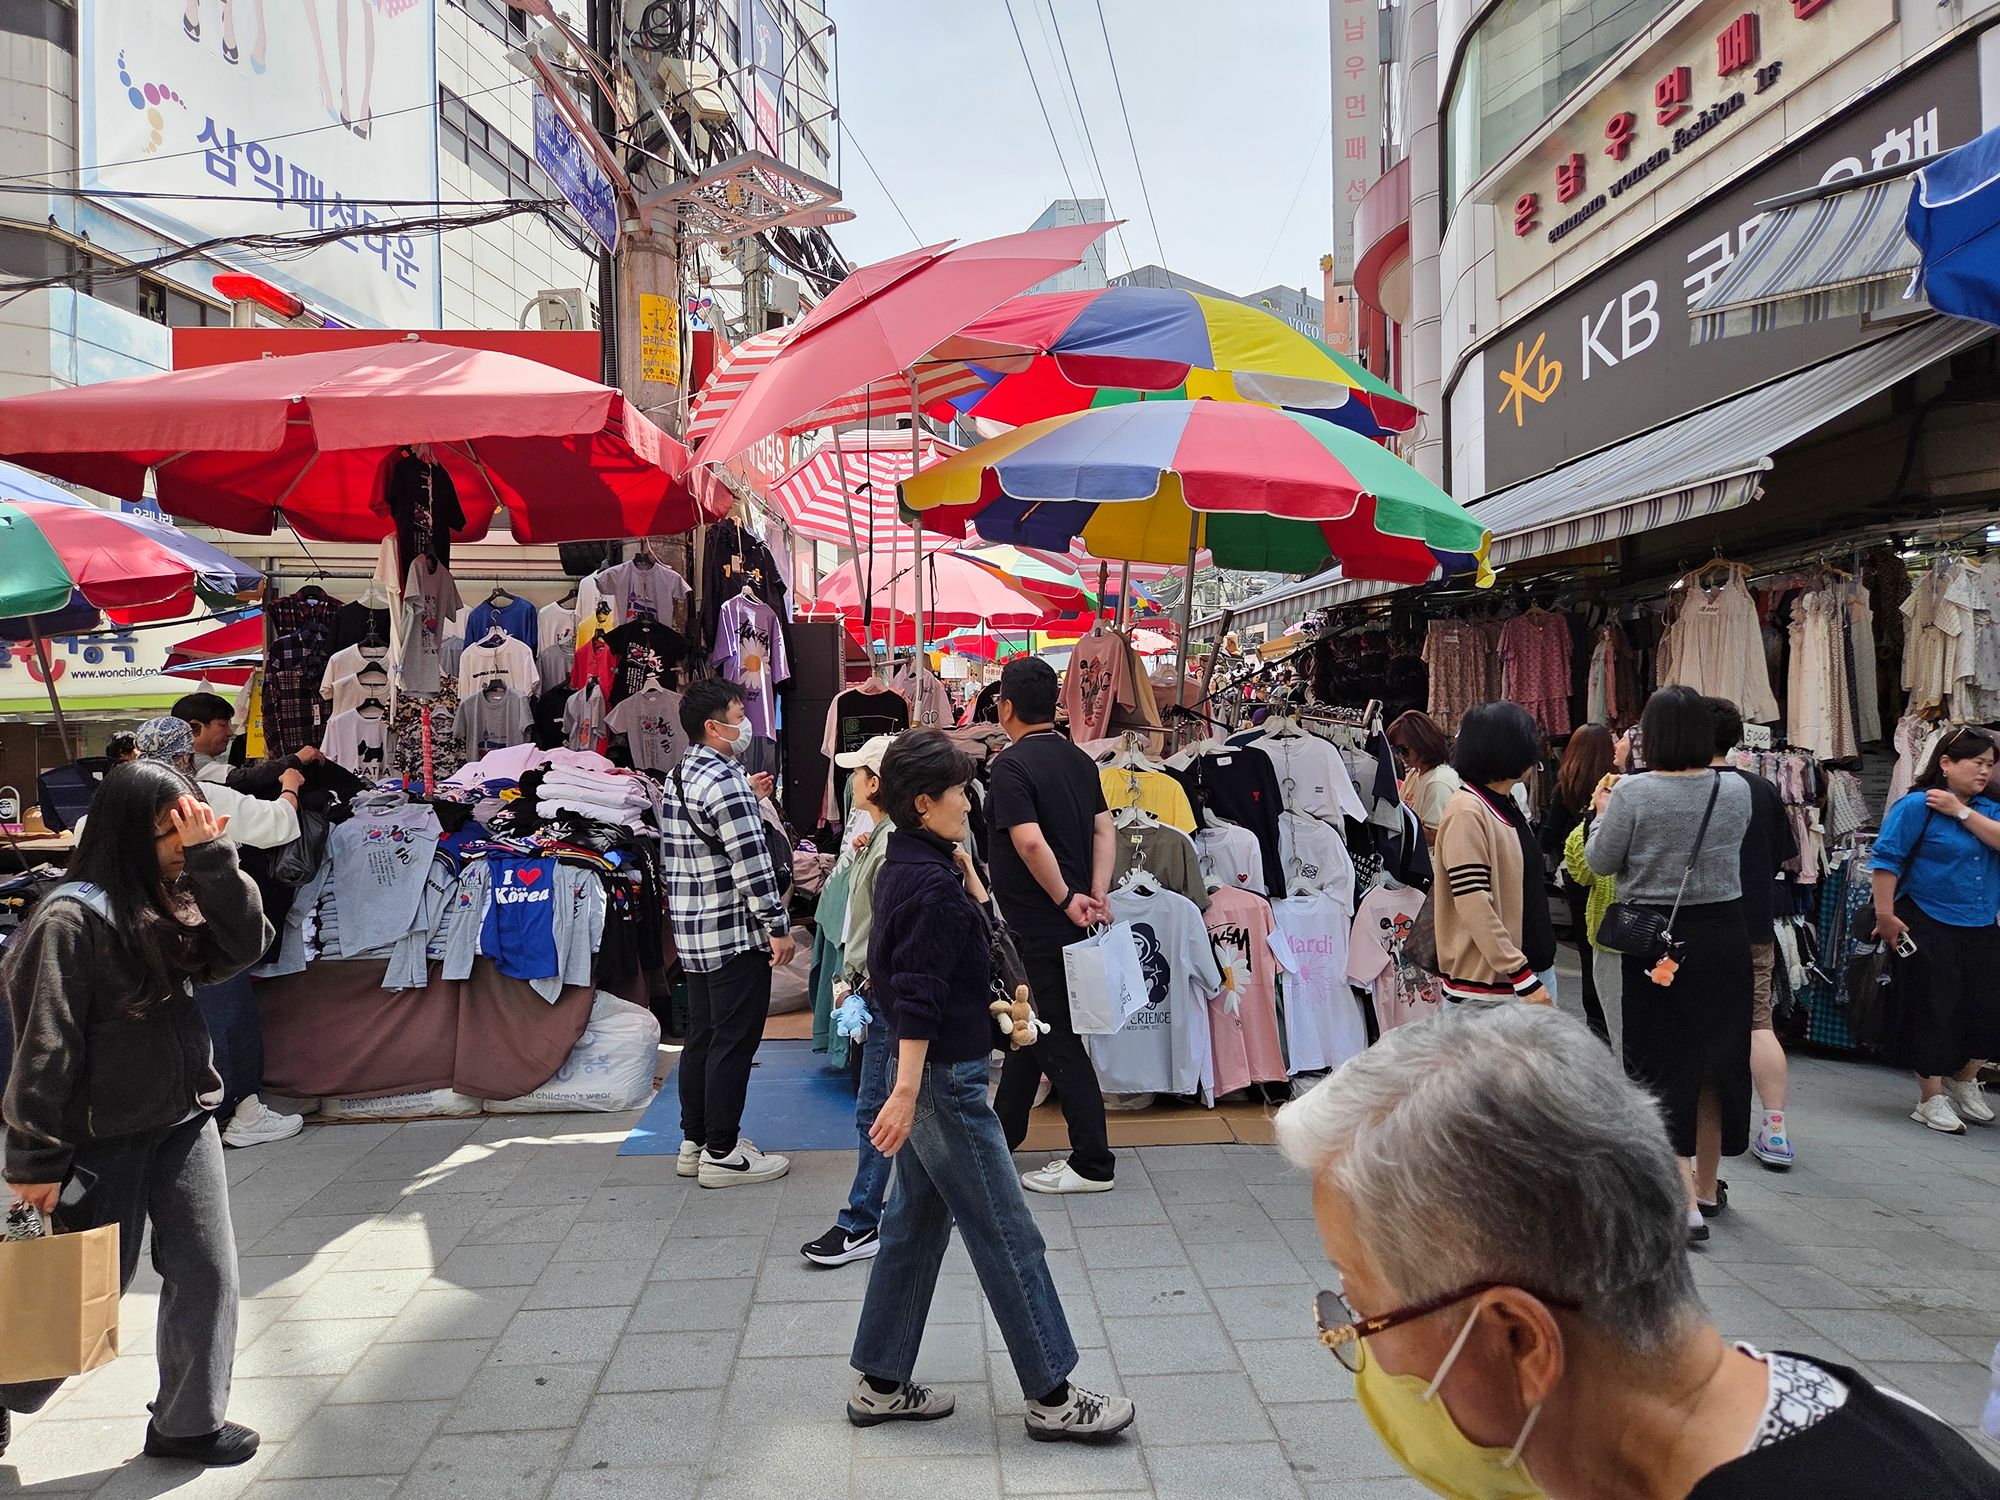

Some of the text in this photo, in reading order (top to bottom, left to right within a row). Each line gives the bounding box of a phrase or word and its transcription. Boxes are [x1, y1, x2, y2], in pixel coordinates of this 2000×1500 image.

[1343, 0, 1367, 204] 남우먼패션
[1608, 146, 1671, 199] women
[1671, 91, 1745, 155] fashion
[1581, 279, 1661, 381] KB
[1745, 729, 1770, 742] 5000
[502, 869, 514, 886] I
[495, 886, 550, 905] Korea
[534, 1090, 583, 1101] children's
[585, 1091, 612, 1100] wear
